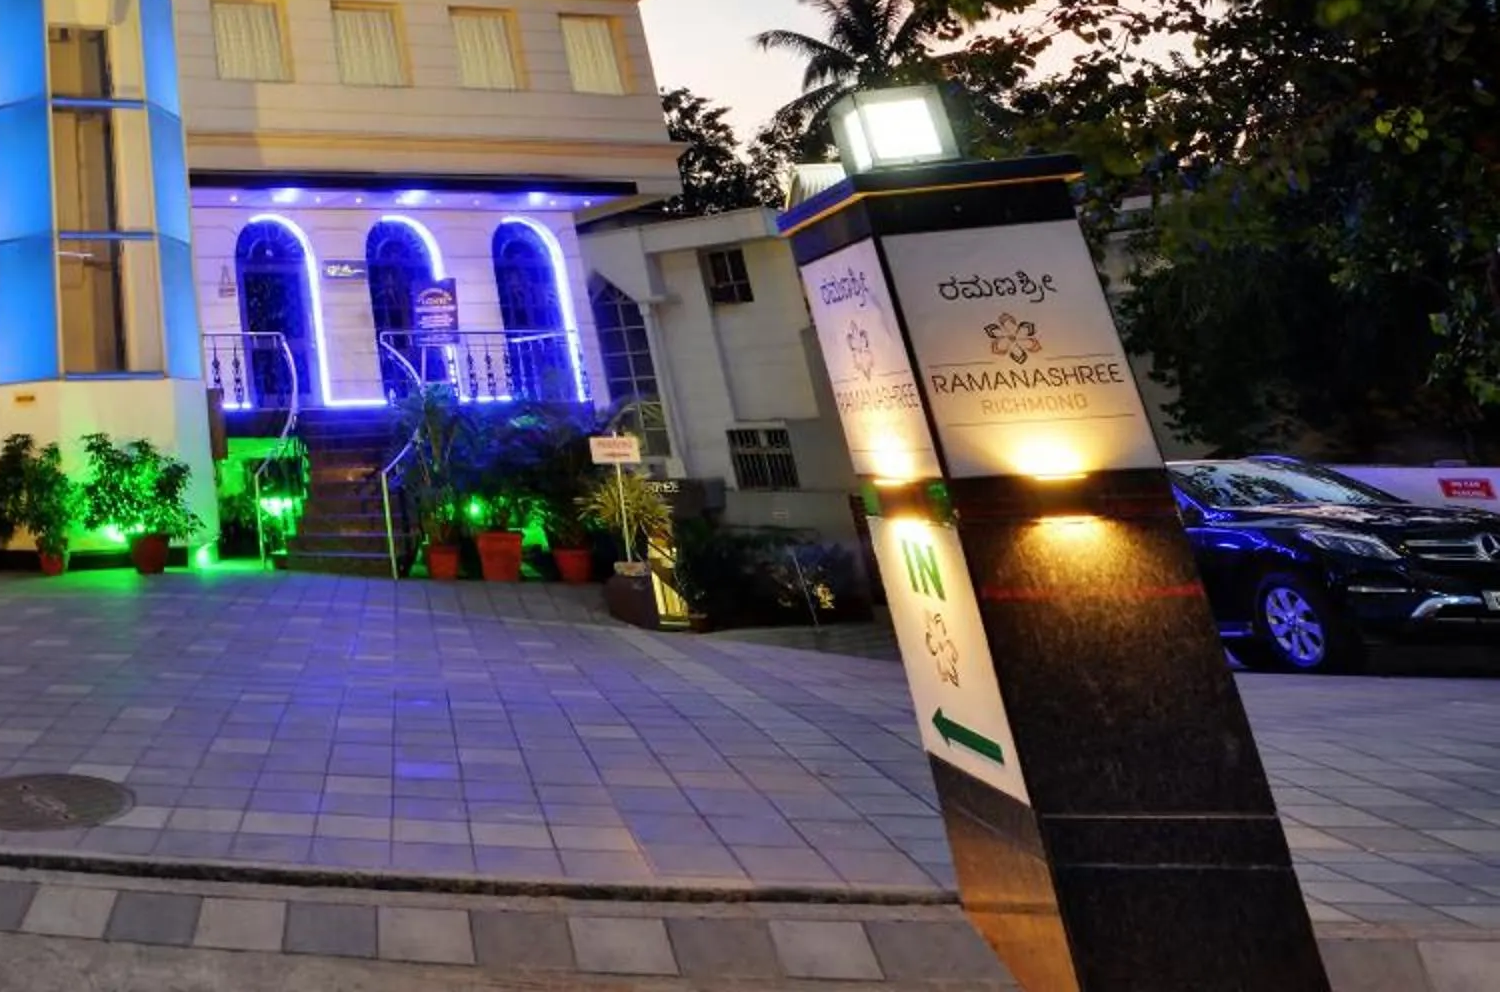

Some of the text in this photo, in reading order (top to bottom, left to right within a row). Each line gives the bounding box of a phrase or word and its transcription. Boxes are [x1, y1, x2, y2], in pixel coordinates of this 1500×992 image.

[937, 269, 1058, 303] ರಮಣಶ್ರೀ
[931, 363, 1125, 394] RAMANASHREE
[981, 392, 1088, 416] RICHMOND
[901, 539, 946, 602] IN
